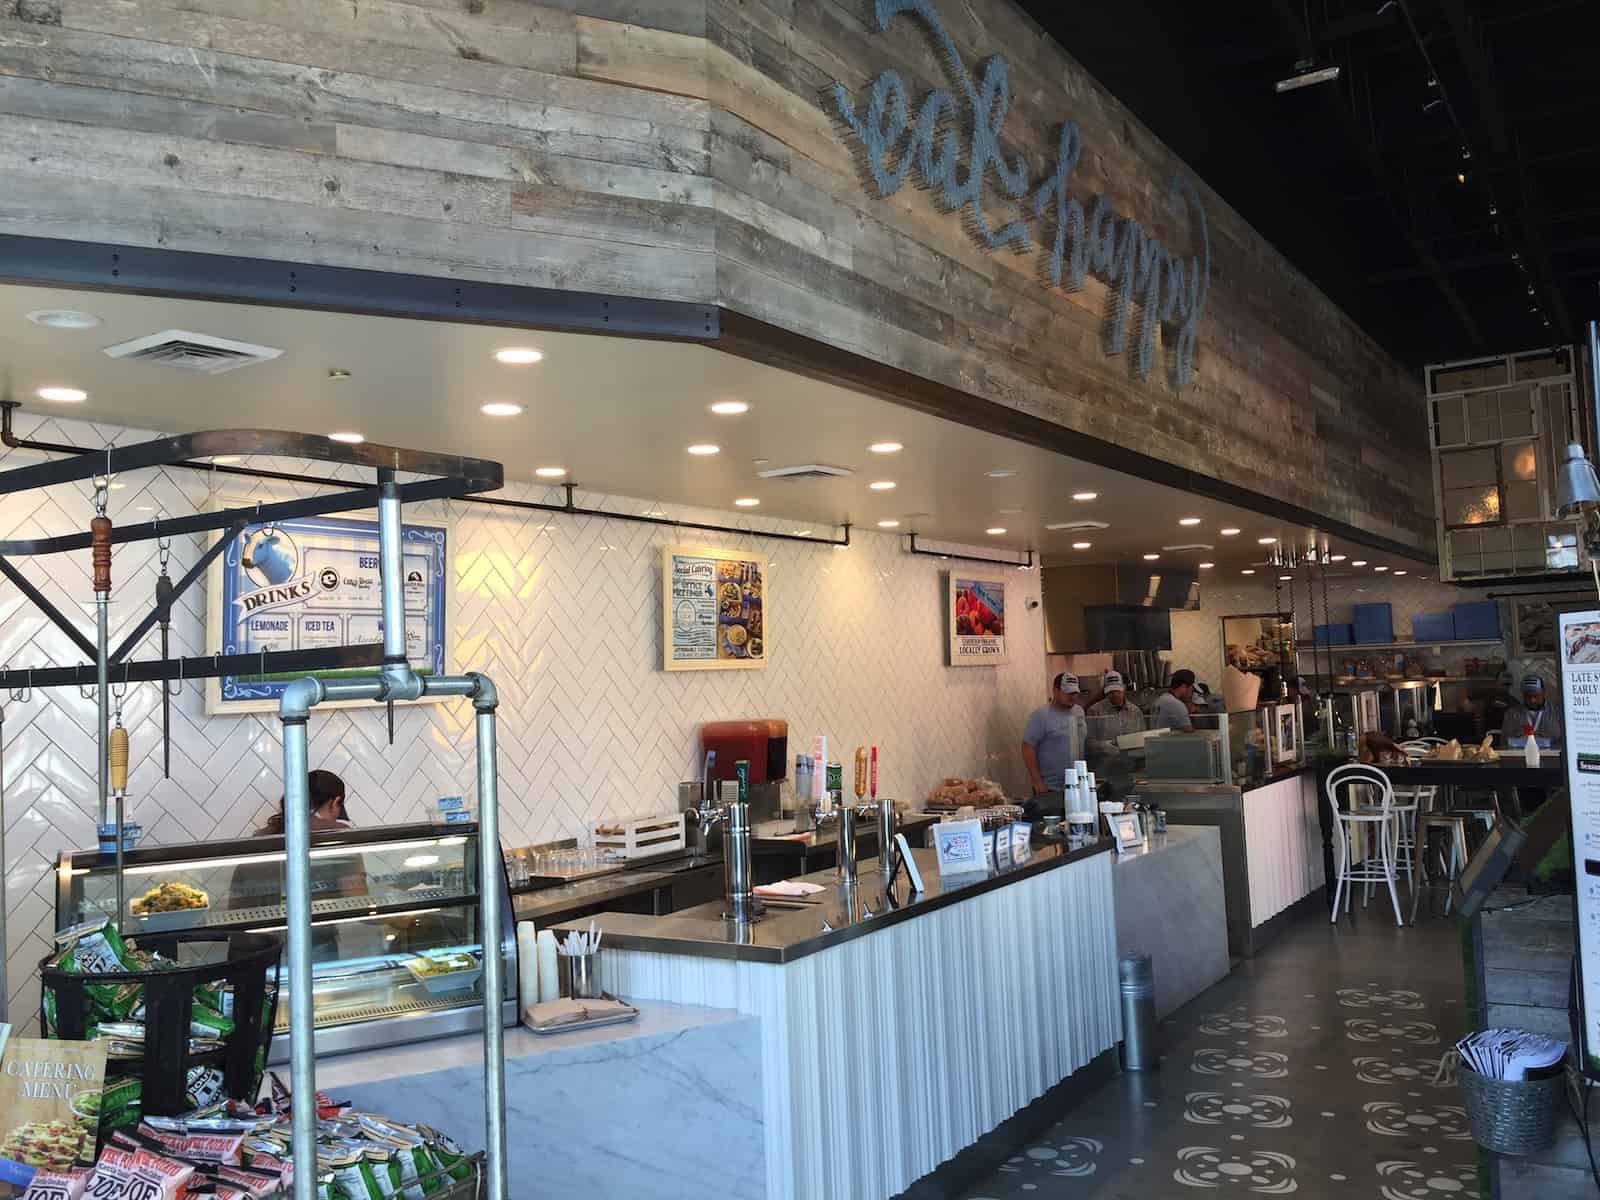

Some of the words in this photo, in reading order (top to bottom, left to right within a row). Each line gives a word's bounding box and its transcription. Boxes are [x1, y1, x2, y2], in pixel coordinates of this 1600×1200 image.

[1034, 119, 1212, 392] happy
[359, 556, 378, 569] BEER
[243, 580, 311, 611] DRINKS
[251, 620, 289, 632] LEMONADE
[305, 621, 320, 632] ICED
[322, 621, 335, 631] TEA
[1571, 671, 1593, 683] LATE
[1573, 684, 1598, 695] EARLY
[1573, 696, 1591, 706] 2015
[7, 1061, 97, 1081] CATERING
[22, 1081, 79, 1100] MENU
